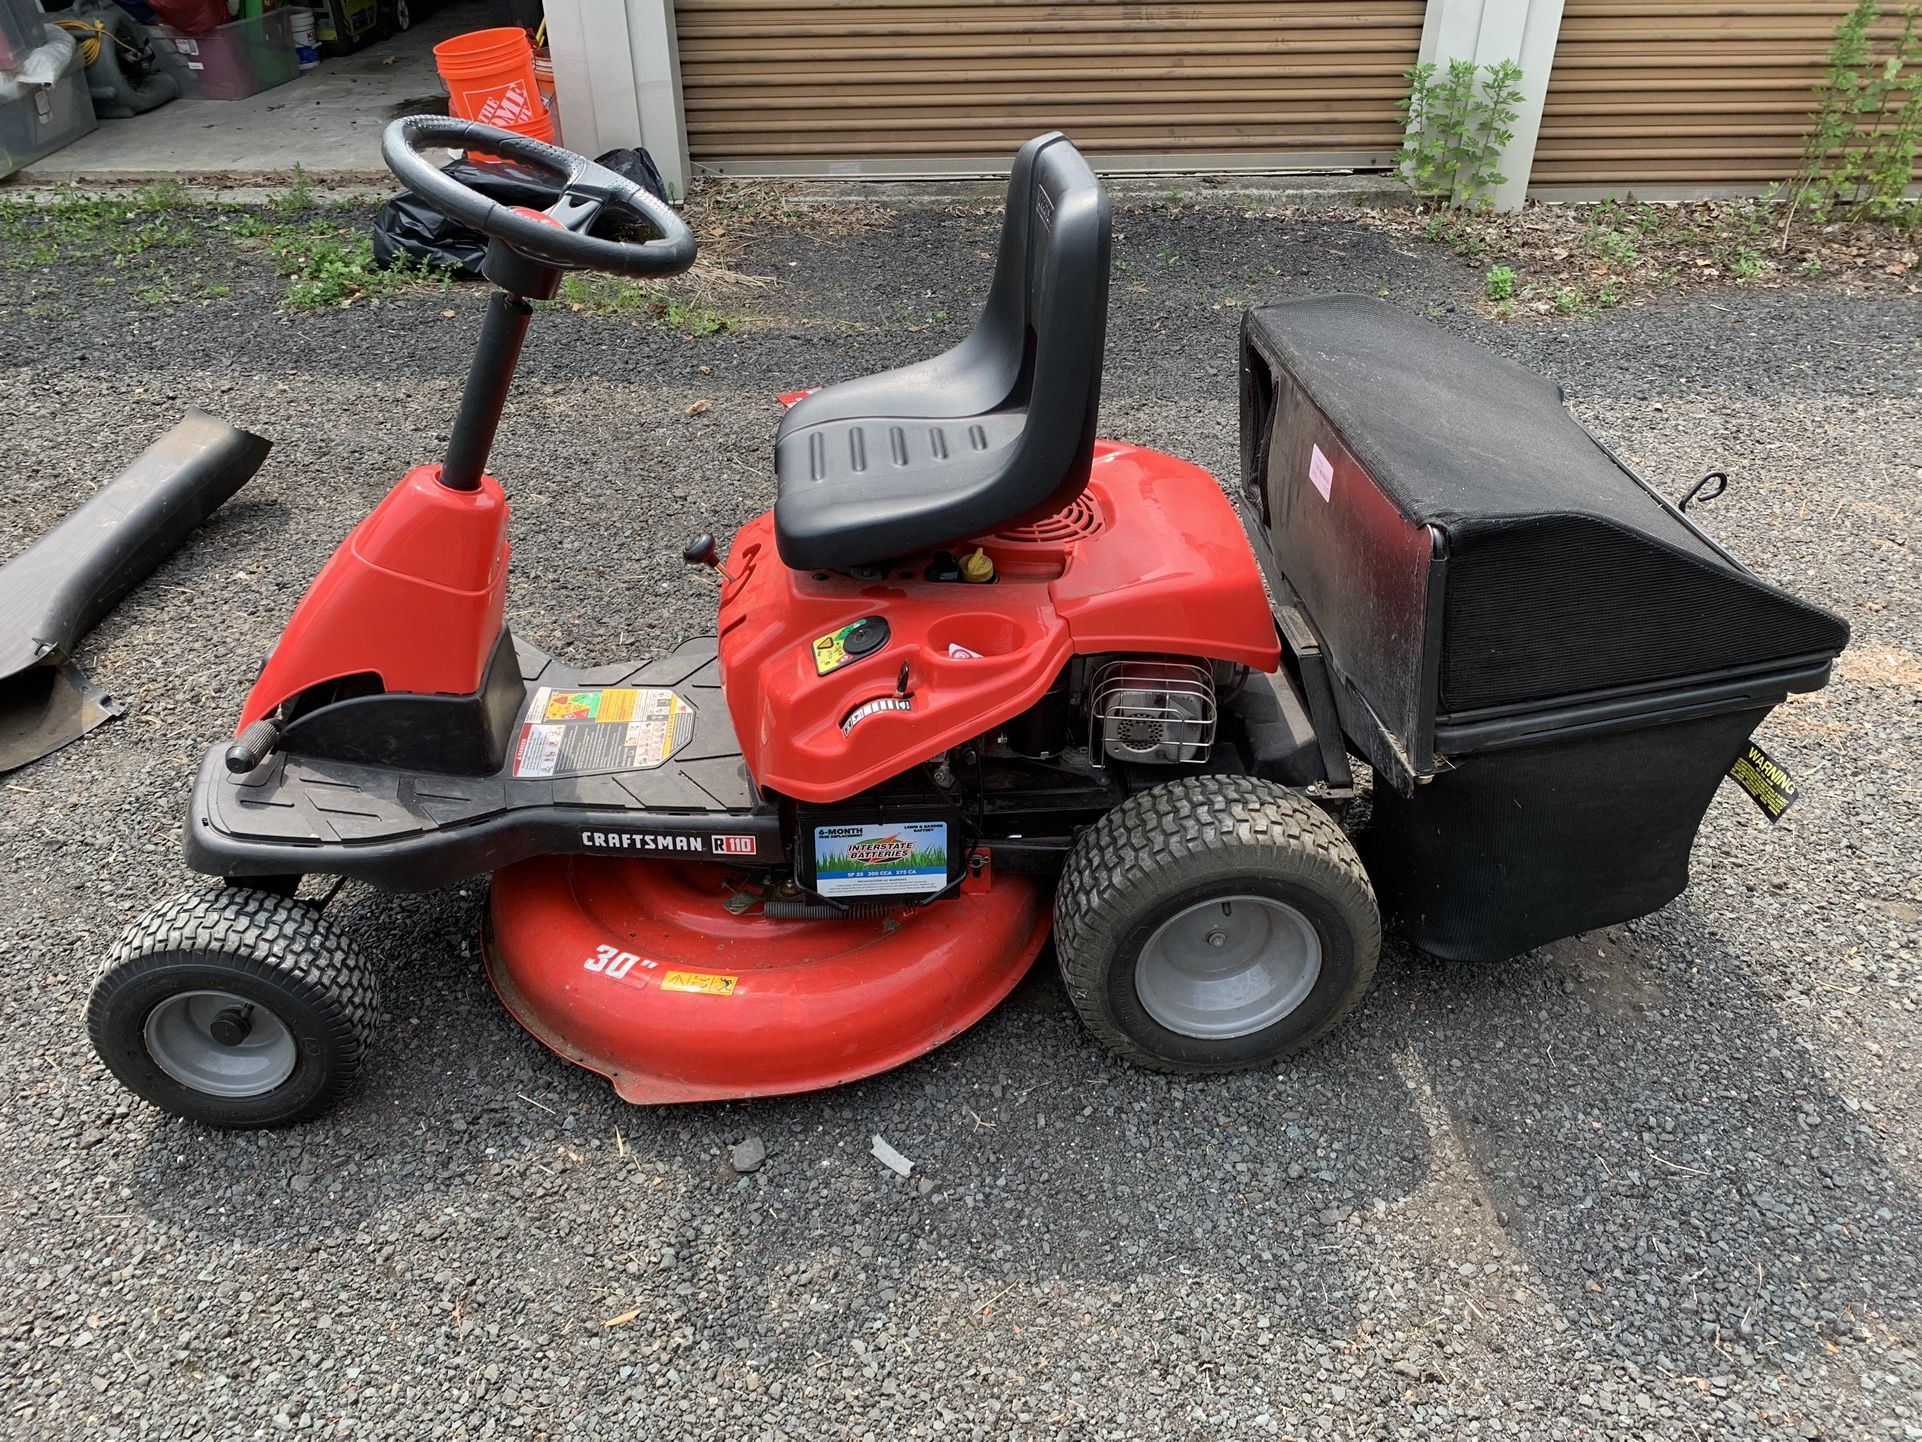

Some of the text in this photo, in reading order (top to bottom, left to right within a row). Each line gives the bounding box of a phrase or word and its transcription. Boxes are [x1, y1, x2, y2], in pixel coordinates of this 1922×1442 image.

[478, 96, 500, 124] THE
[1748, 746, 1796, 795] WARNING
[581, 831, 703, 852] CRAFTSMAN
[848, 842, 913, 851] INTERSTATE
[850, 850, 908, 858] BATTERIES
[583, 943, 659, 980] 30"
